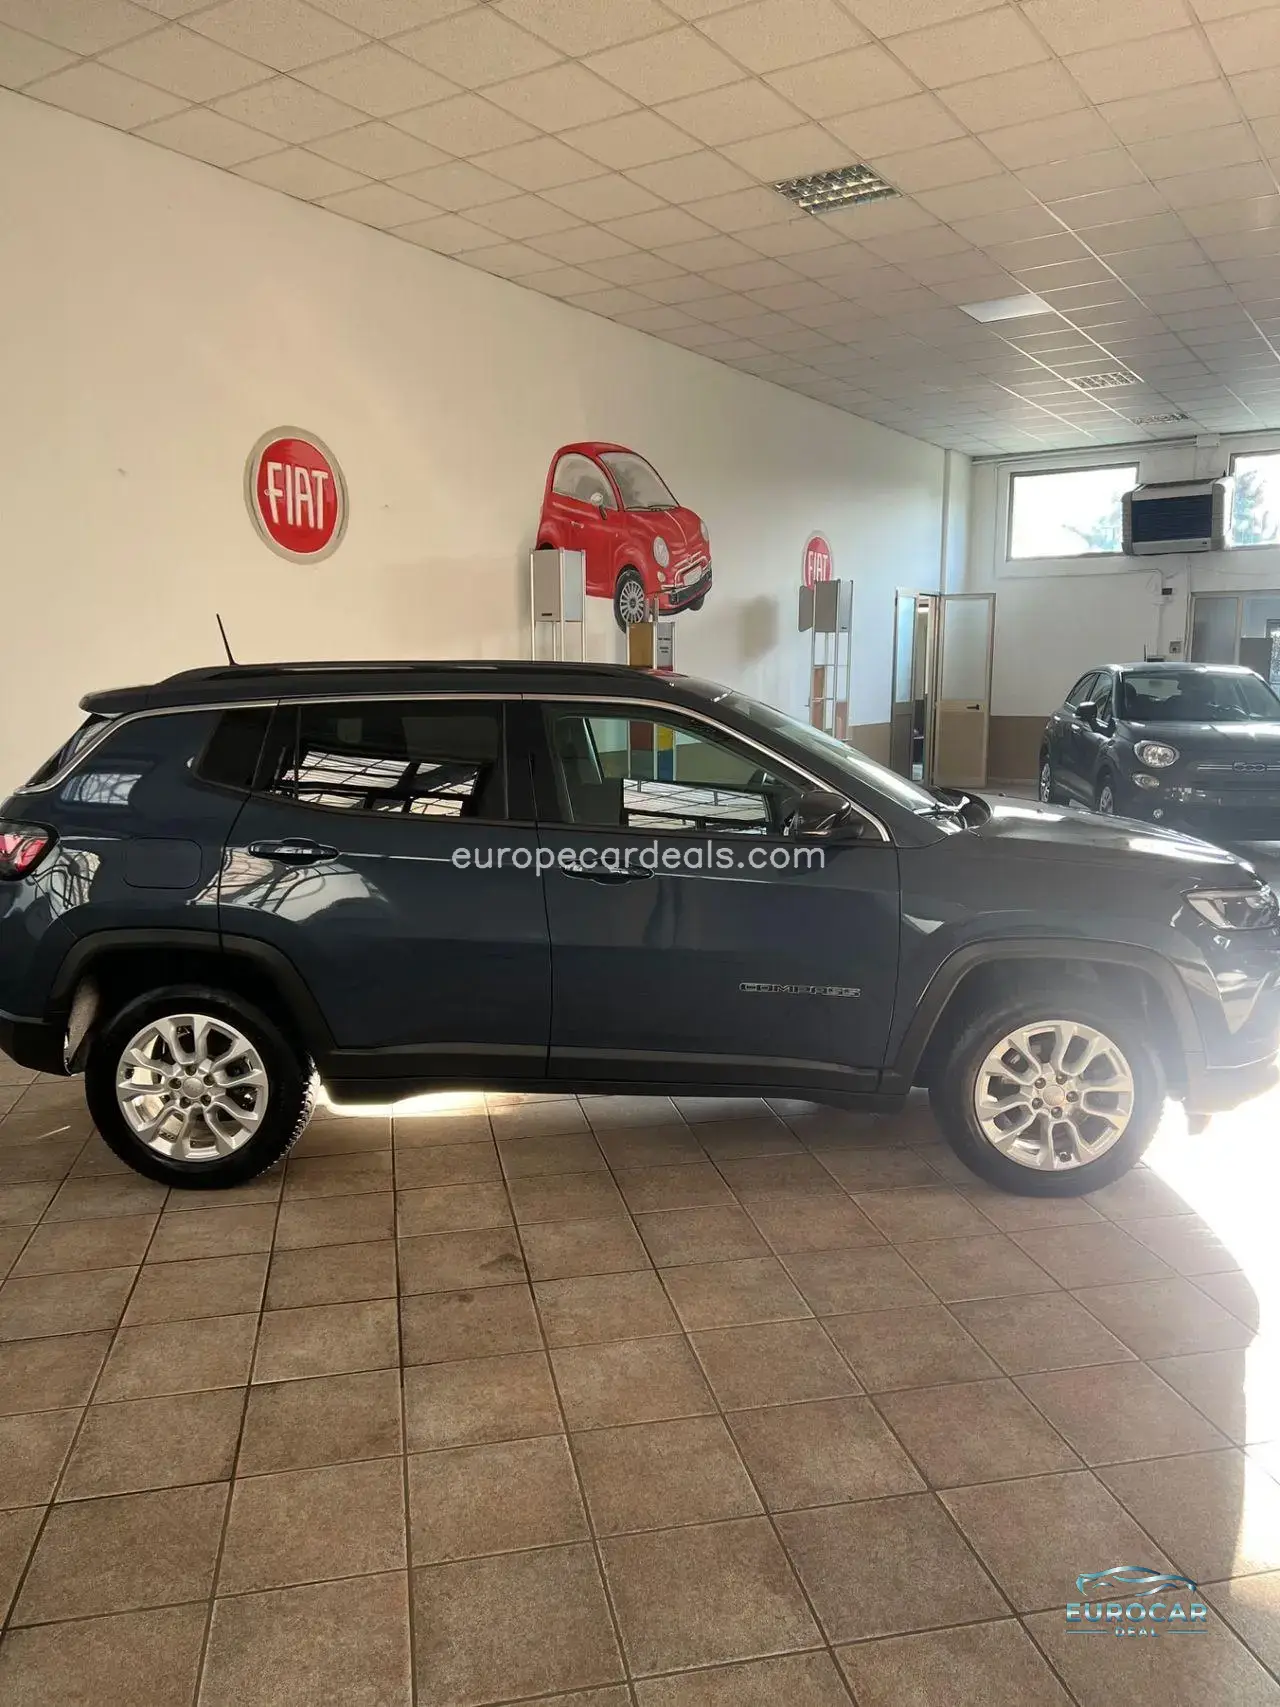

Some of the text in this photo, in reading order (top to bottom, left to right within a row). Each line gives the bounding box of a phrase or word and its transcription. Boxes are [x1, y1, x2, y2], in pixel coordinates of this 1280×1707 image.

[264, 461, 329, 530] FIAT
[808, 550, 828, 585] FIAT
[739, 982, 861, 998] COMPASS
